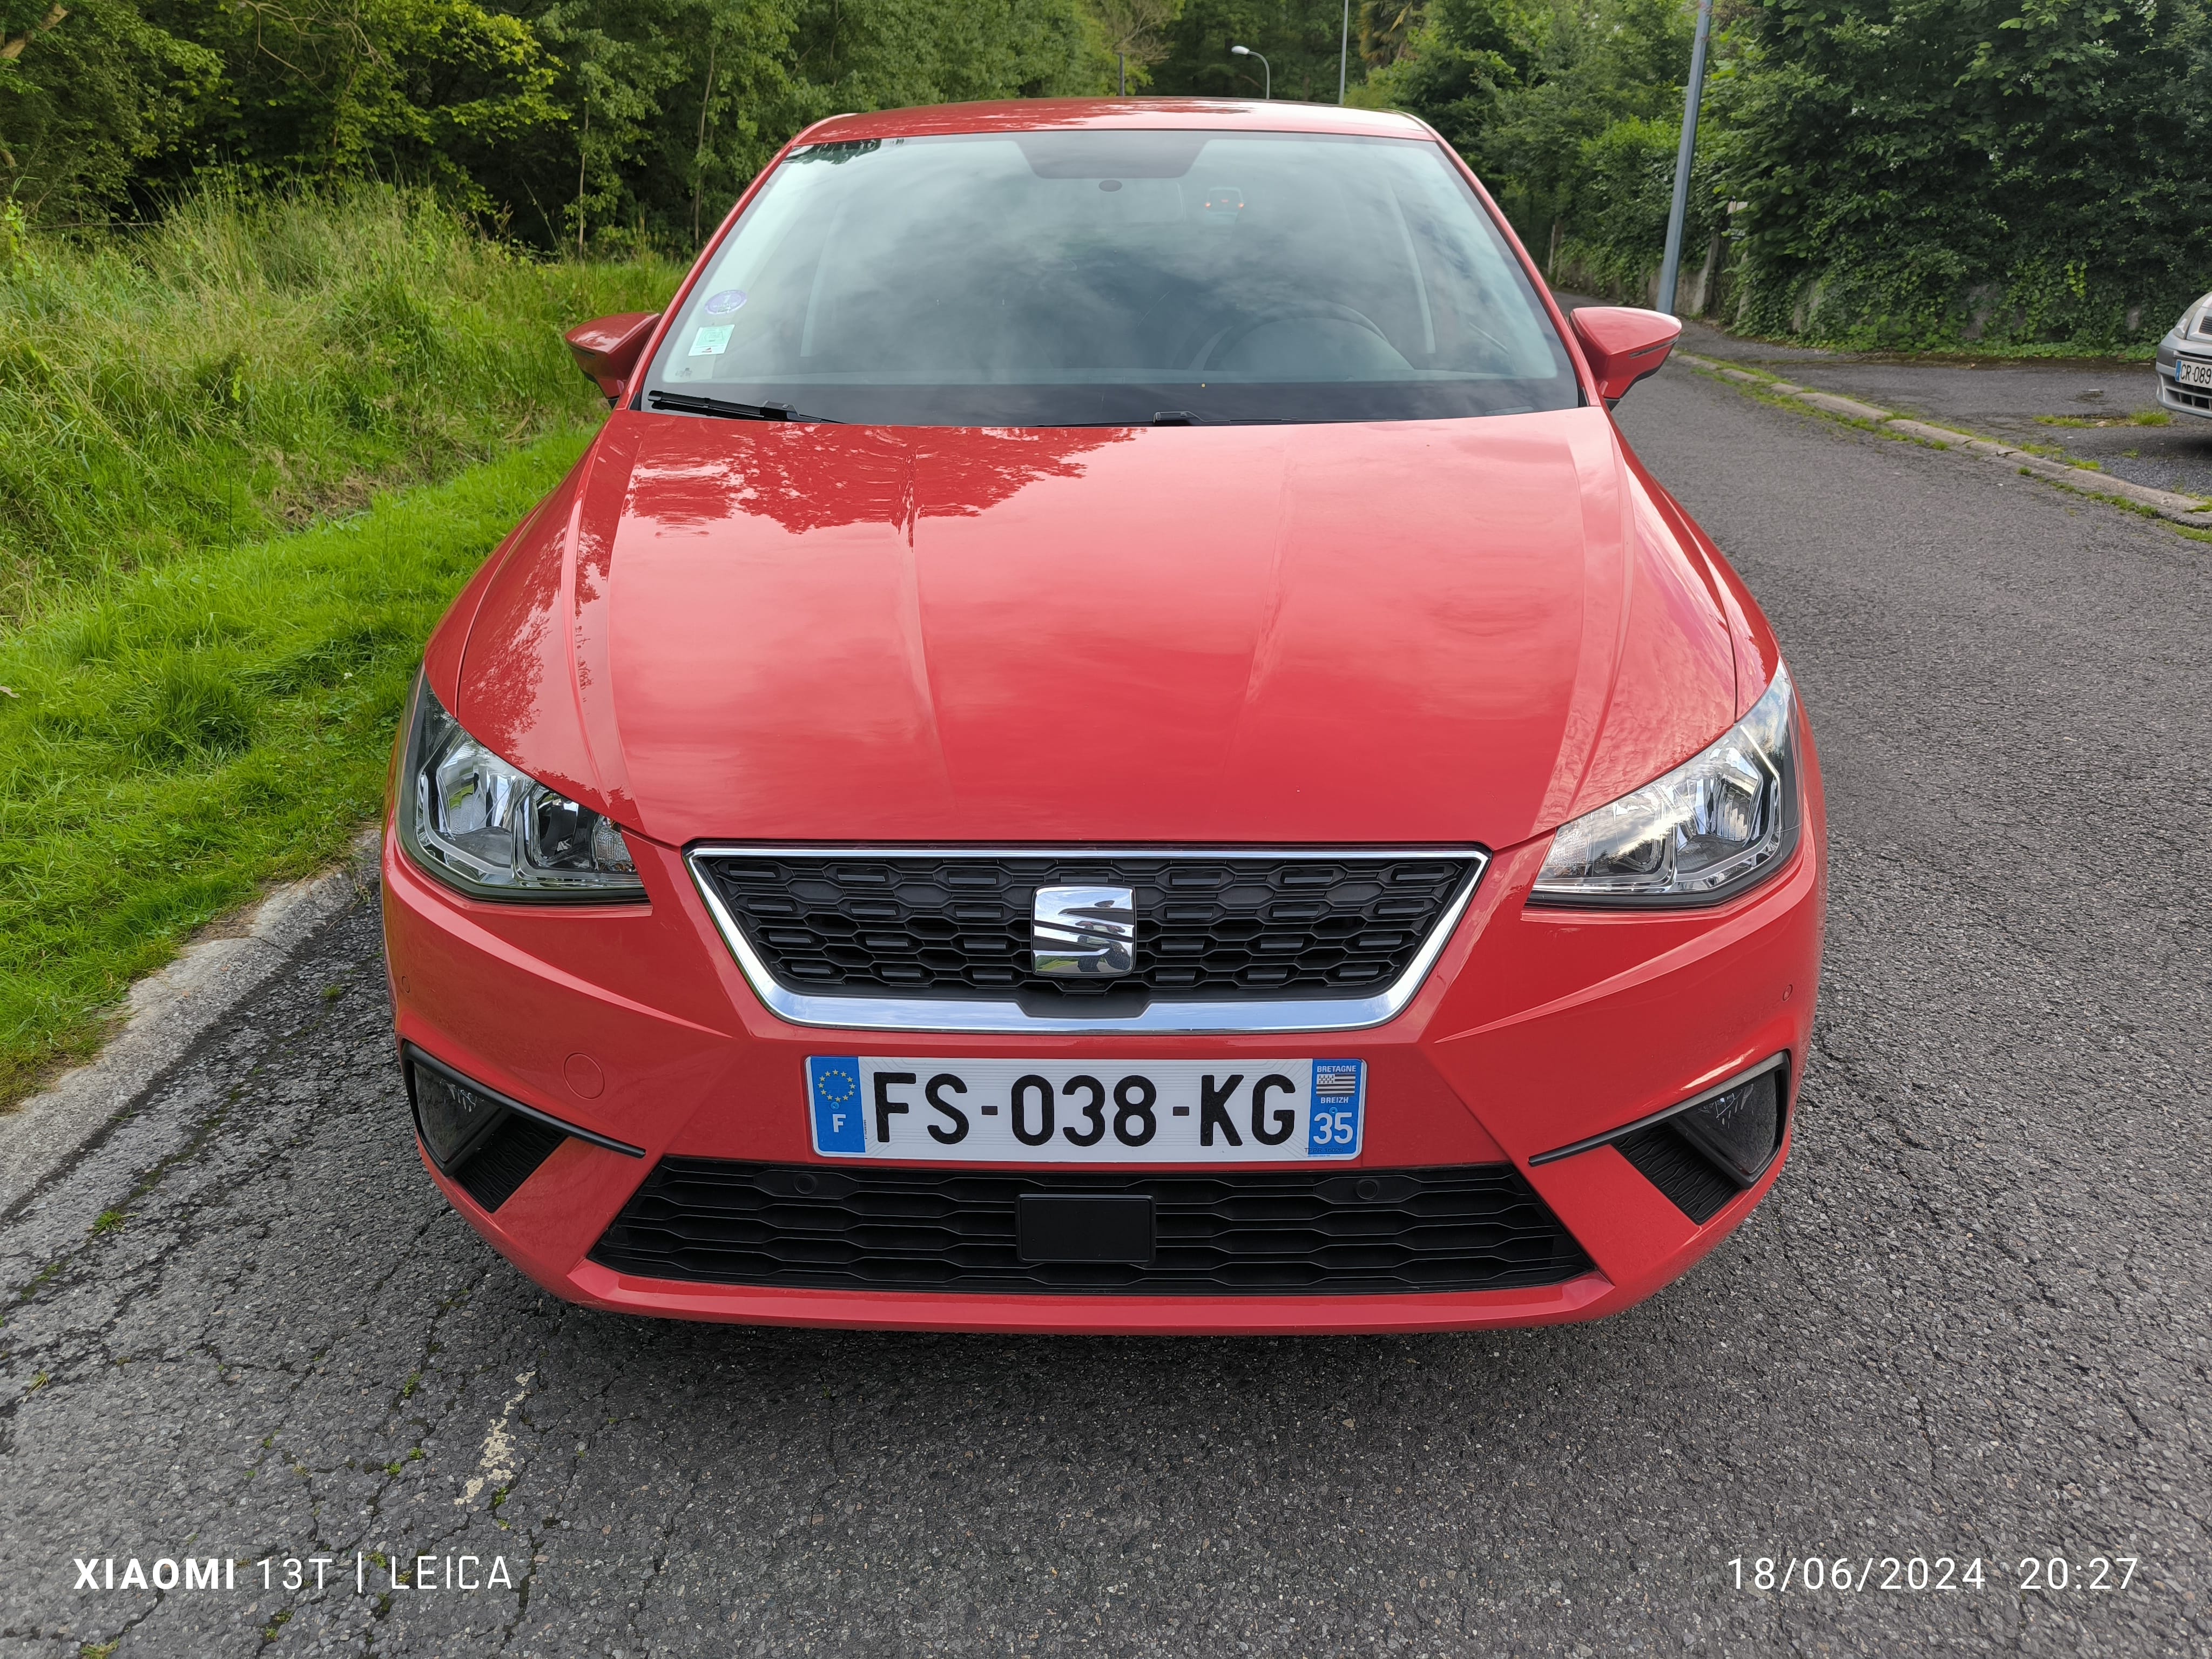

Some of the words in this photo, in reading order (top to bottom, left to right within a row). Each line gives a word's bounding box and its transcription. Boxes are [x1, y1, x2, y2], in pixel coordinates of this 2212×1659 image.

[832, 1114, 846, 1132] F
[873, 1071, 1296, 1148] FS-038-KG
[1313, 1112, 1353, 1144] 35
